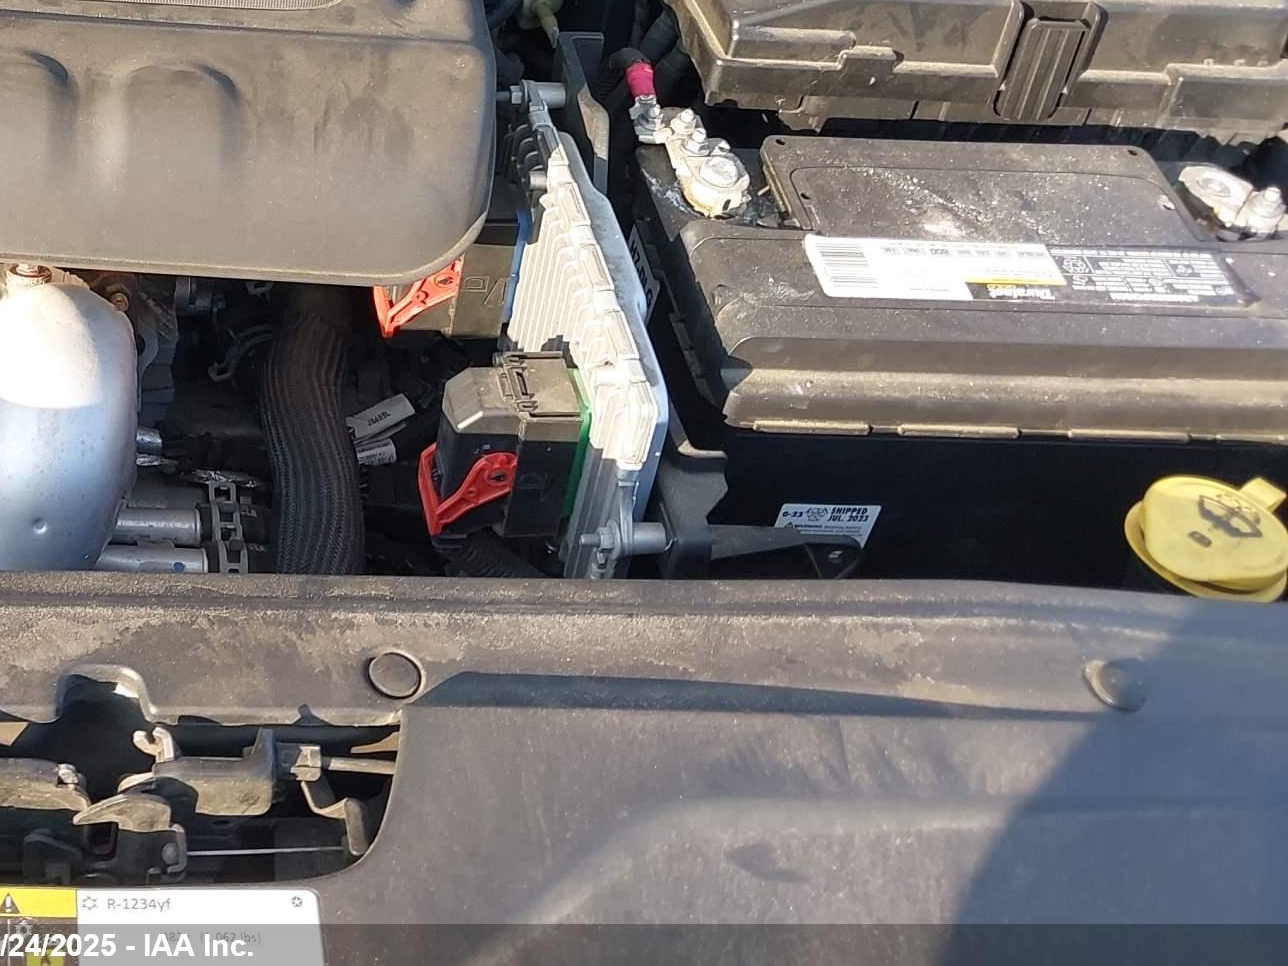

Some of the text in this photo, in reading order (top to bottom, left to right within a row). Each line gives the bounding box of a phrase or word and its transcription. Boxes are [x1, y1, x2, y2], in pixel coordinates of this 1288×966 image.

[830, 506, 868, 515] SHIPPED
[827, 514, 869, 522] JUL. 2023
[107, 898, 171, 912] R-1234yf
